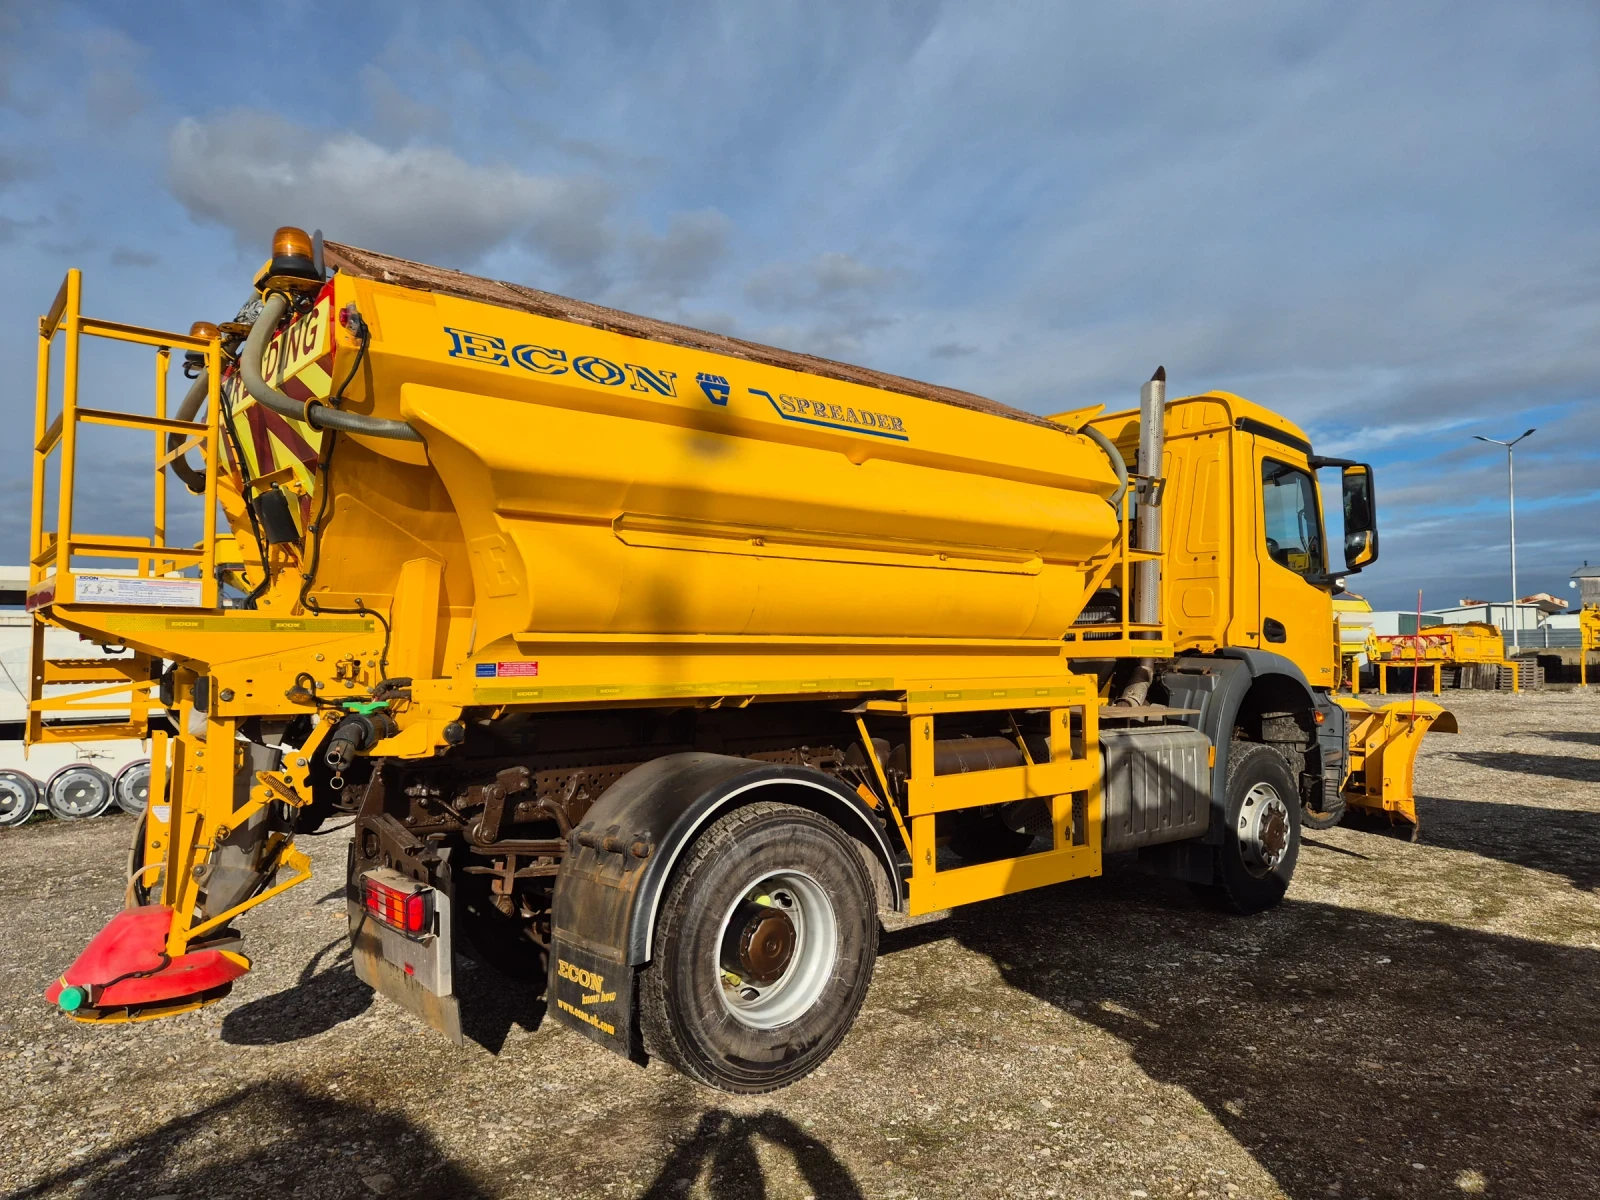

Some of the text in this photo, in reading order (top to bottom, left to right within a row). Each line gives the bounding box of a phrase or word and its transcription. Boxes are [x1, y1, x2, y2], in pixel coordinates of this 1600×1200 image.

[443, 327, 677, 397] ECON
[695, 371, 730, 387] ZERO
[778, 393, 907, 433] SPREADER
[557, 958, 604, 993] ECON
[581, 990, 617, 1005] know how
[557, 998, 615, 1036] www.econ.uk.com
